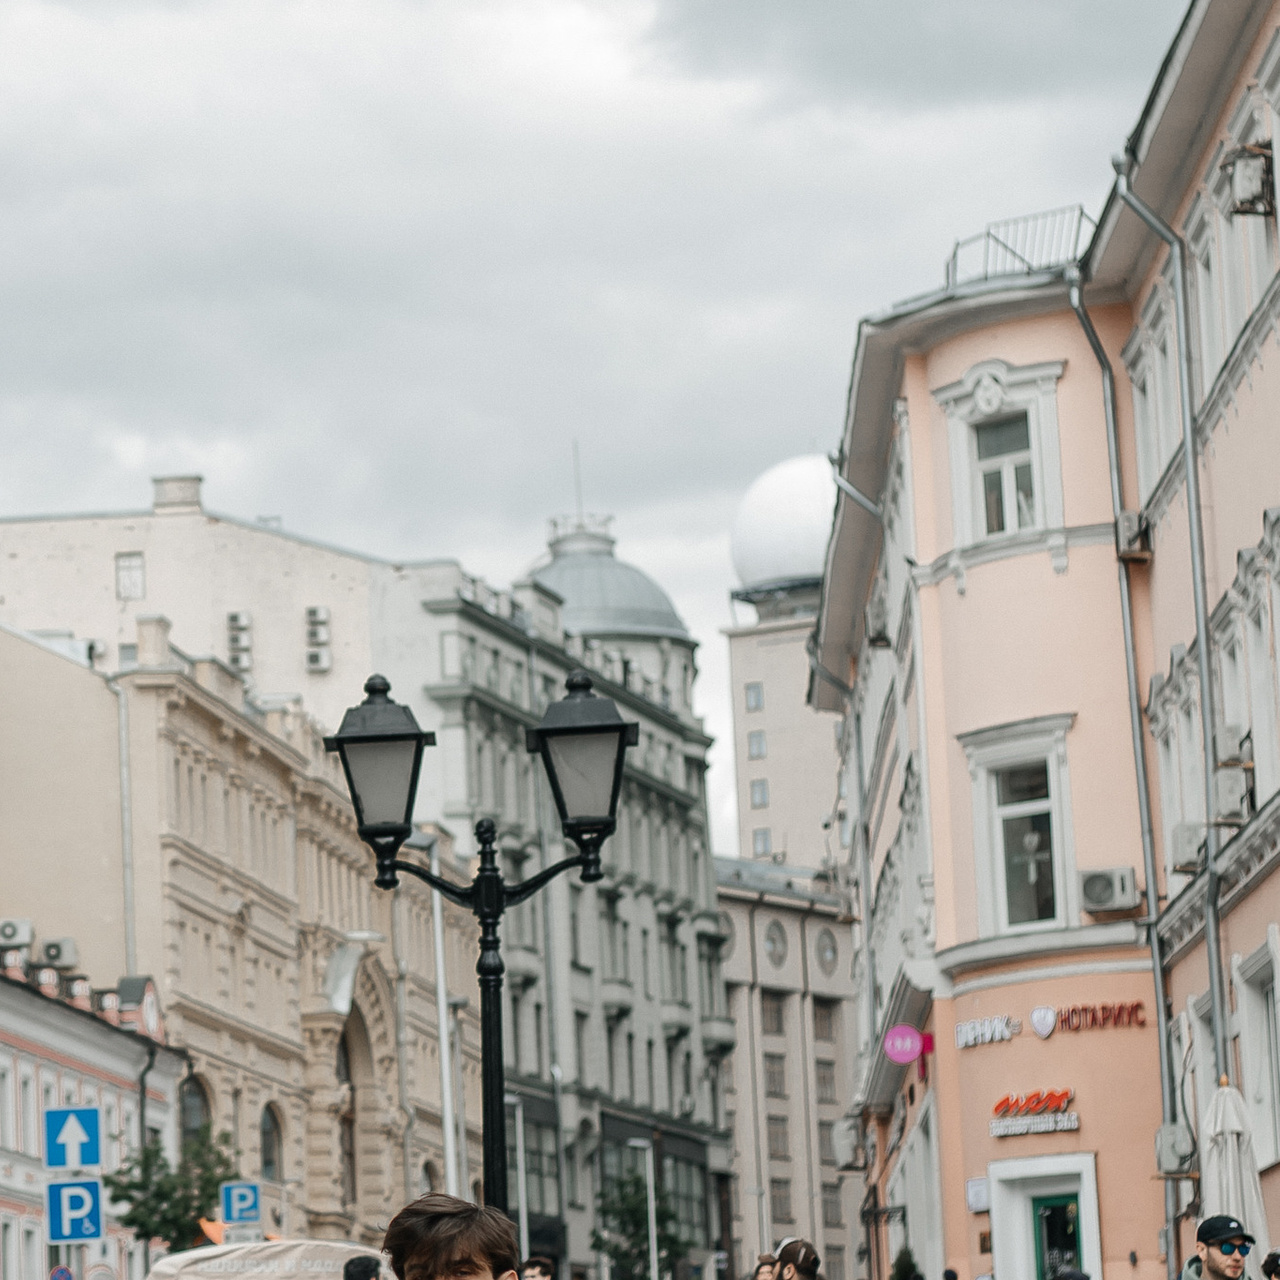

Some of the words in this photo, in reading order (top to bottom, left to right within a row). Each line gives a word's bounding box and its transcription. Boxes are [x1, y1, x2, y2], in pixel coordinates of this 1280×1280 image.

[1058, 1002, 1146, 1032] НОТАРИУС
[60, 1186, 93, 1236] P
[231, 1187, 255, 1220] P
